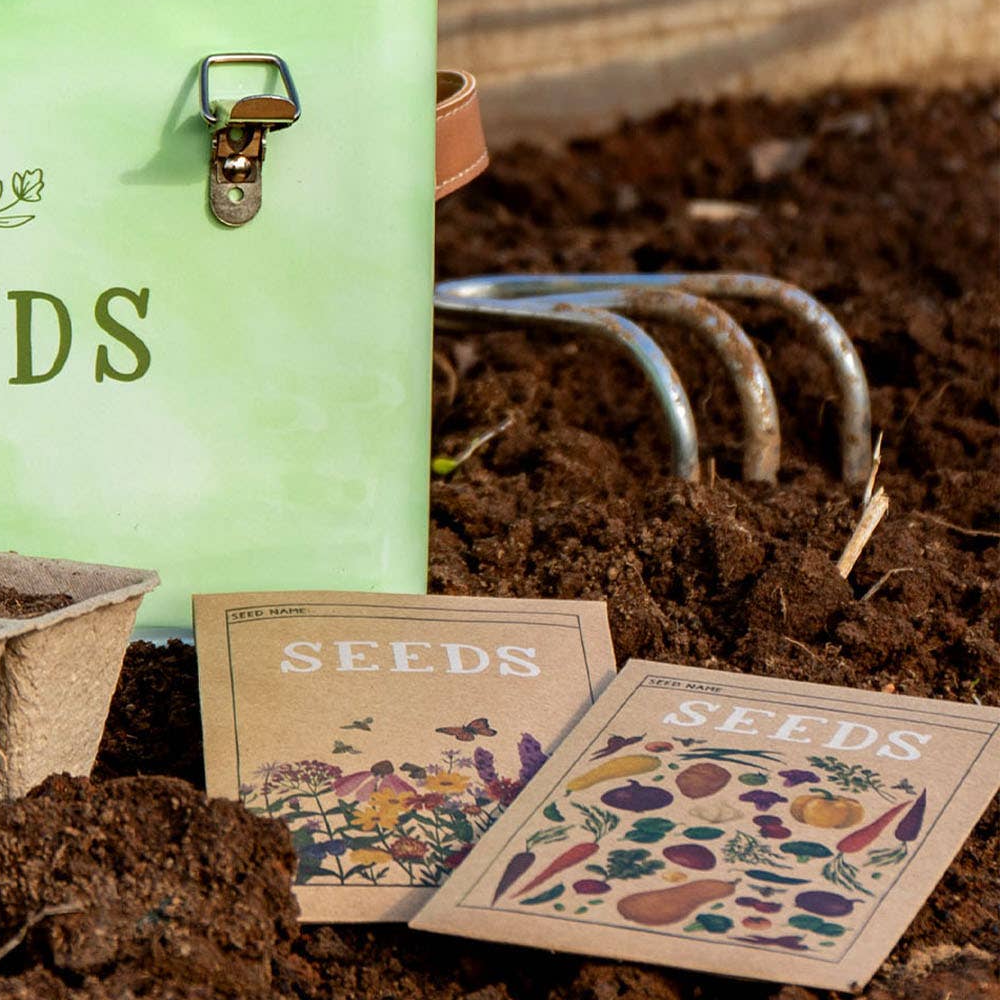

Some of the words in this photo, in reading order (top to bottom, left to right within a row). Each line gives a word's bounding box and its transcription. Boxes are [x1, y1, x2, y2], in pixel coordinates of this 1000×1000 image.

[231, 609, 264, 621] SEED
[280, 640, 541, 678] SEEDS
[648, 678, 681, 688] SEED
[662, 699, 932, 762] SEEDS
